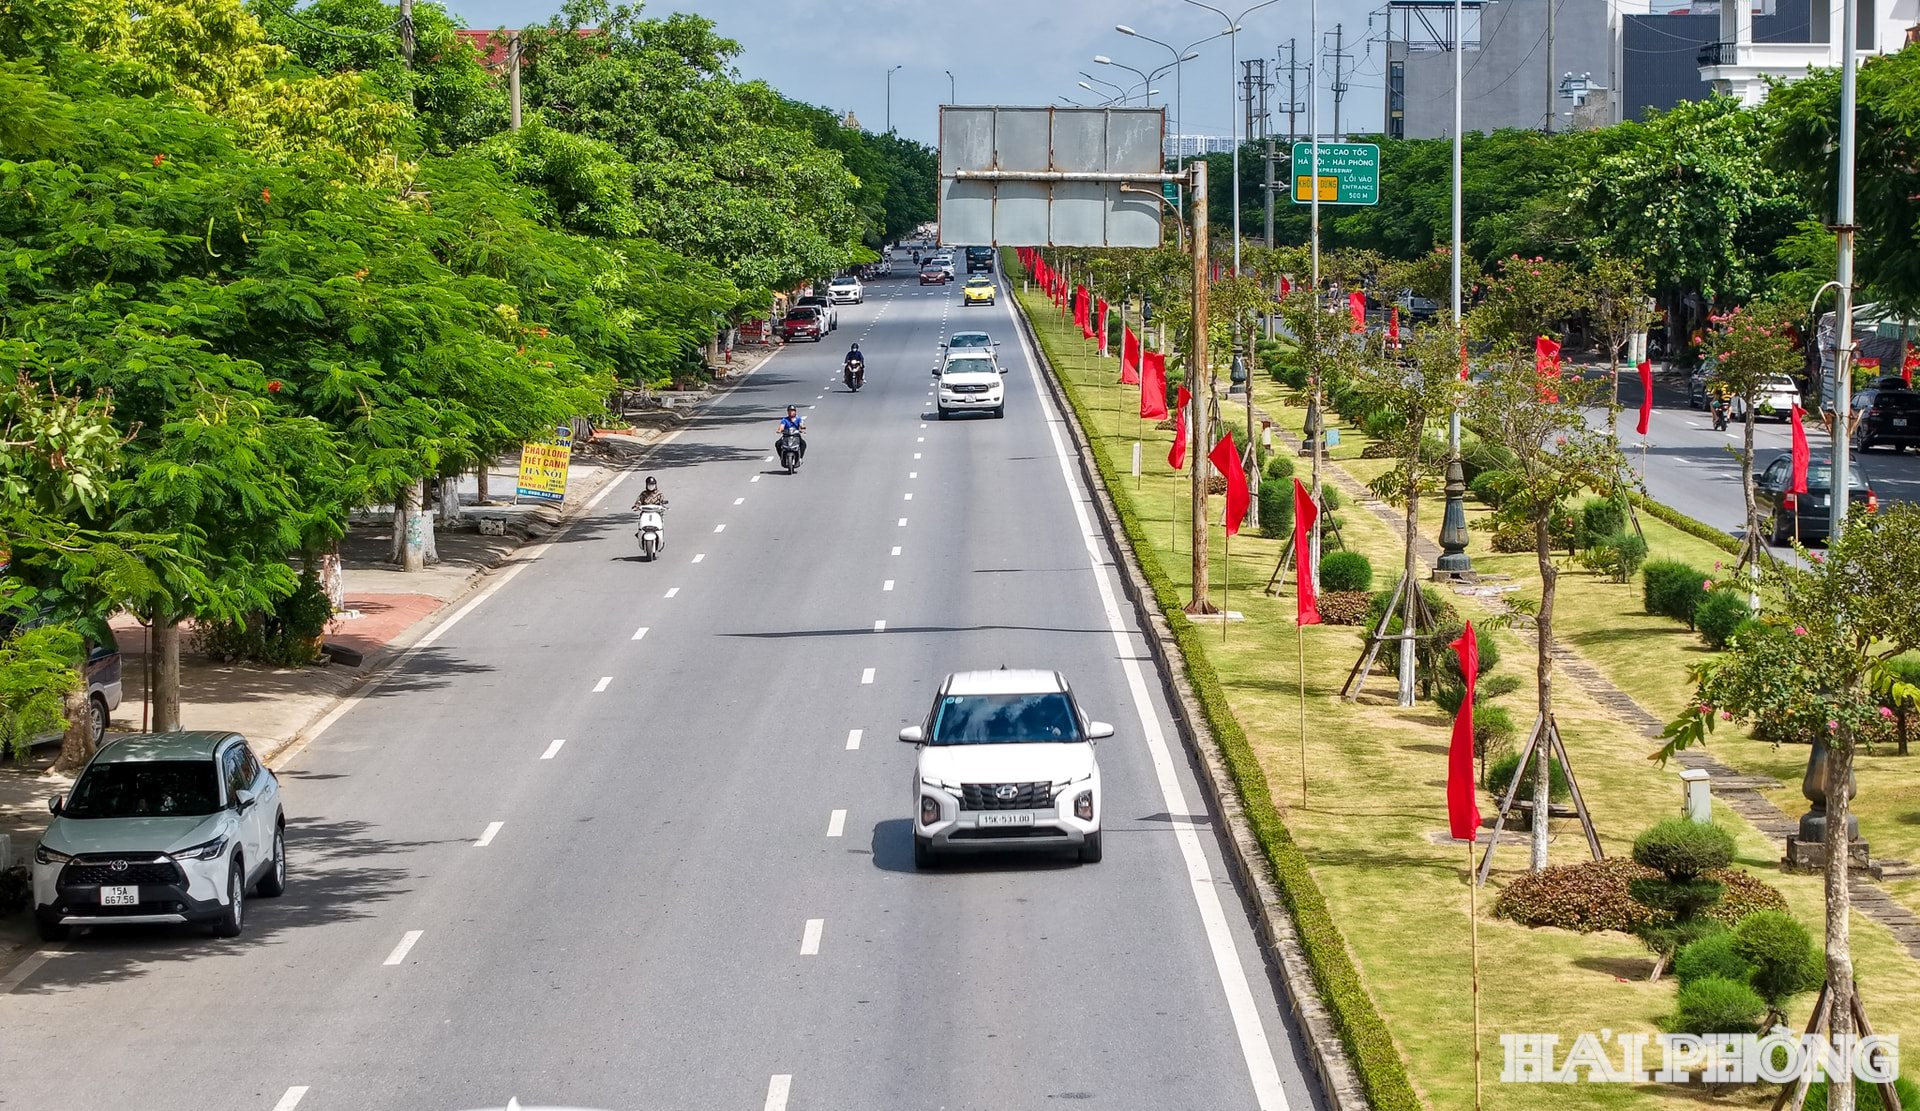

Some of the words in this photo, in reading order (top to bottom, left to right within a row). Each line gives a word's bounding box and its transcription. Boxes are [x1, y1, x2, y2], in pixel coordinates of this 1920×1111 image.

[1352, 148, 1368, 156] TỐC
[1348, 158, 1374, 166] PHÒNG
[1343, 174, 1357, 182] LỐI
[112, 887, 128, 895] 15A
